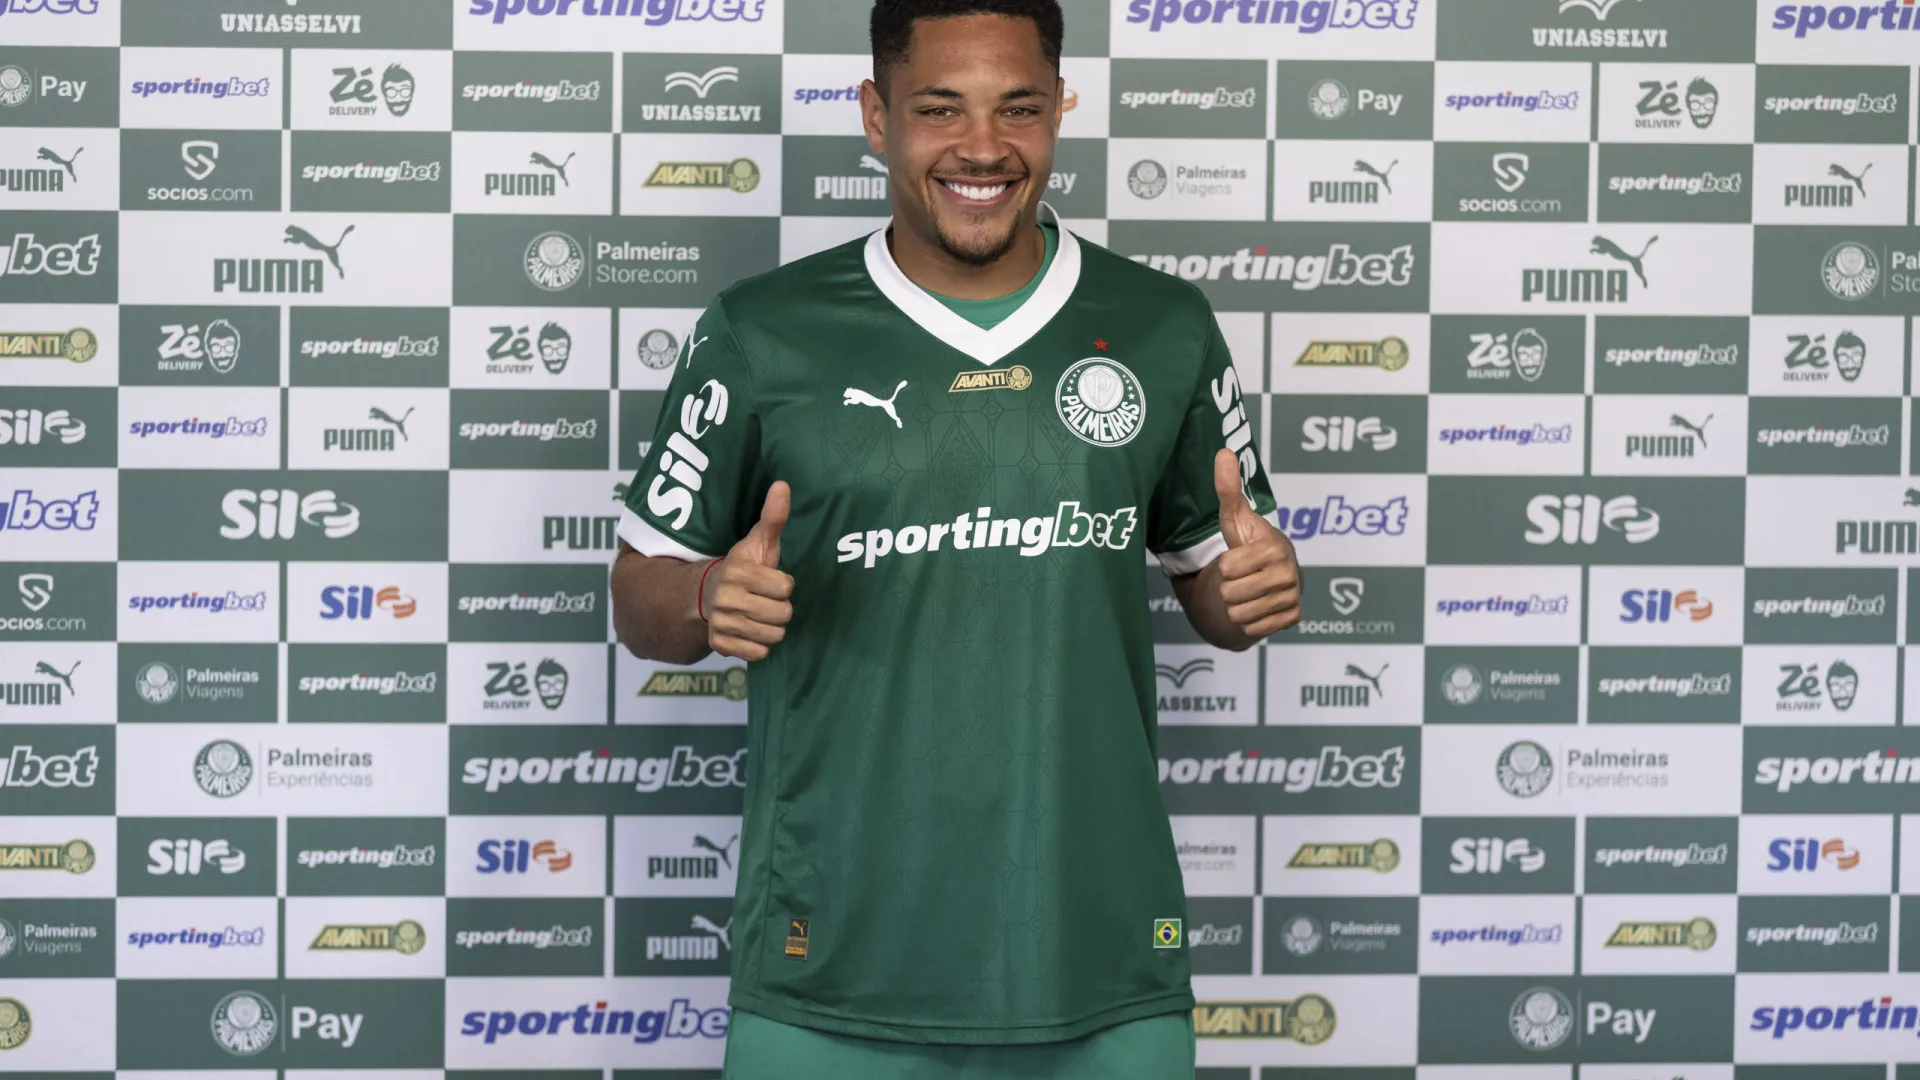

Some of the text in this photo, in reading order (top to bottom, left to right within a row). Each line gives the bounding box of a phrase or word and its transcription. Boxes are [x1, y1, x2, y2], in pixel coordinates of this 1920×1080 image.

[221, 14, 361, 33] UNIASSELVI
[1772, 0, 1920, 38] sporti
[1532, 28, 1667, 47] UNIASSELVI
[41, 76, 86, 102] Pay
[132, 77, 269, 98] sportingbet
[329, 67, 377, 103] Zé
[462, 80, 600, 102] sportingbet
[1120, 87, 1255, 109] sportingbet
[1358, 89, 1402, 116] Pay
[1446, 90, 1578, 112] sportingbet
[1636, 81, 1682, 116] Zé
[1764, 93, 1897, 115] sportingbet
[329, 106, 377, 116] DELIVERY
[641, 104, 760, 121] UNIASSELVI
[1635, 119, 1681, 128] DELIVERY
[302, 161, 440, 183] sportingbet
[651, 165, 723, 184] AVANTI
[1176, 166, 1246, 179] Palmeiras
[1609, 172, 1741, 194] sportingbet
[148, 188, 252, 201] SOCIOS.com
[485, 174, 555, 196] PUMA
[815, 176, 886, 199] PUMA
[1177, 183, 1230, 197] Viagens
[1309, 181, 1378, 204] PUMA
[1785, 185, 1853, 207] PUMA
[1459, 199, 1560, 212] SOCIOS.com
[597, 241, 699, 261] Palmeiras
[214, 258, 323, 293] PUMA
[597, 264, 697, 283] Store.com
[1522, 269, 1628, 303] PUMA
[158, 324, 203, 359] Zé
[301, 336, 439, 358] sportingbet
[487, 326, 534, 361] Zé
[1467, 333, 1513, 367] Zé
[1784, 334, 1829, 369] Zé
[1301, 344, 1373, 362] AVANTI
[1605, 344, 1738, 367] sportingbet
[158, 361, 203, 370] DELIVERY
[486, 364, 534, 374] DELIVERY
[1467, 369, 1511, 379] DELIVERY
[1783, 372, 1829, 381] DELIVERY
[955, 372, 1006, 389] AVANTI
[1062, 395, 1140, 442] PALMEIRAS
[1211, 366, 1252, 453] Sil
[130, 417, 267, 438] sportingbet
[459, 418, 596, 440] sportingbet
[1302, 416, 1356, 451] Sil
[1440, 424, 1572, 445] sportingbet
[1757, 424, 1889, 447] sportingbet
[324, 429, 394, 451] PUMA
[1626, 435, 1694, 458] PUMA
[648, 431, 709, 530] Sil
[220, 489, 299, 539] Sil
[1525, 494, 1601, 544] Sil
[837, 501, 1137, 568] sportingbet
[1836, 521, 1920, 554] PUM
[129, 592, 266, 613] sportingbet
[320, 586, 374, 620] Sil
[458, 592, 594, 614] sportingbet
[1436, 595, 1568, 616] sportingbet
[1620, 589, 1672, 623] Sil
[1754, 595, 1885, 618] sportingbet
[1298, 620, 1395, 635] SOCIOS.com
[187, 668, 259, 682] Palmeiras
[299, 672, 436, 694] sportingbet
[484, 662, 531, 697] Zé
[647, 674, 717, 692] AVANTI
[1491, 671, 1560, 685] Palmeiras
[1598, 673, 1731, 696] sportingbet
[1777, 664, 1822, 699] Zé
[187, 686, 243, 700] Viagens
[1300, 685, 1369, 707] PUMA
[1491, 688, 1545, 701] Viagens
[483, 700, 530, 709] DELIVERY
[1776, 702, 1821, 710] DELIVERY
[268, 748, 372, 767] Palmeiras
[1568, 749, 1668, 767] Palmeiras
[268, 772, 372, 787] Experiências
[1568, 772, 1667, 788] Experiências
[147, 839, 203, 875] Sil
[298, 845, 435, 868] sportingbet
[476, 840, 530, 874] Sil
[1295, 847, 1364, 865] AVANTI
[1450, 838, 1503, 873] Sil
[1595, 843, 1727, 867] sportingbet
[1767, 838, 1819, 872] Sil
[648, 856, 718, 879] PUMA
[25, 924, 96, 937] Palmeiras
[128, 927, 264, 948] sportingbet
[317, 928, 388, 947] AVANTI
[456, 925, 592, 948] sportingbet
[1331, 922, 1401, 935] Palmeiras
[1431, 924, 1561, 946] sportingbet
[1612, 925, 1680, 944] AVANTI
[1746, 922, 1878, 945] sportingbet
[25, 940, 81, 955] Viagens
[646, 936, 718, 960] PUMA
[292, 1006, 363, 1047] Pay
[1587, 1002, 1656, 1043] Pay
[1750, 996, 1920, 1040] sportin
